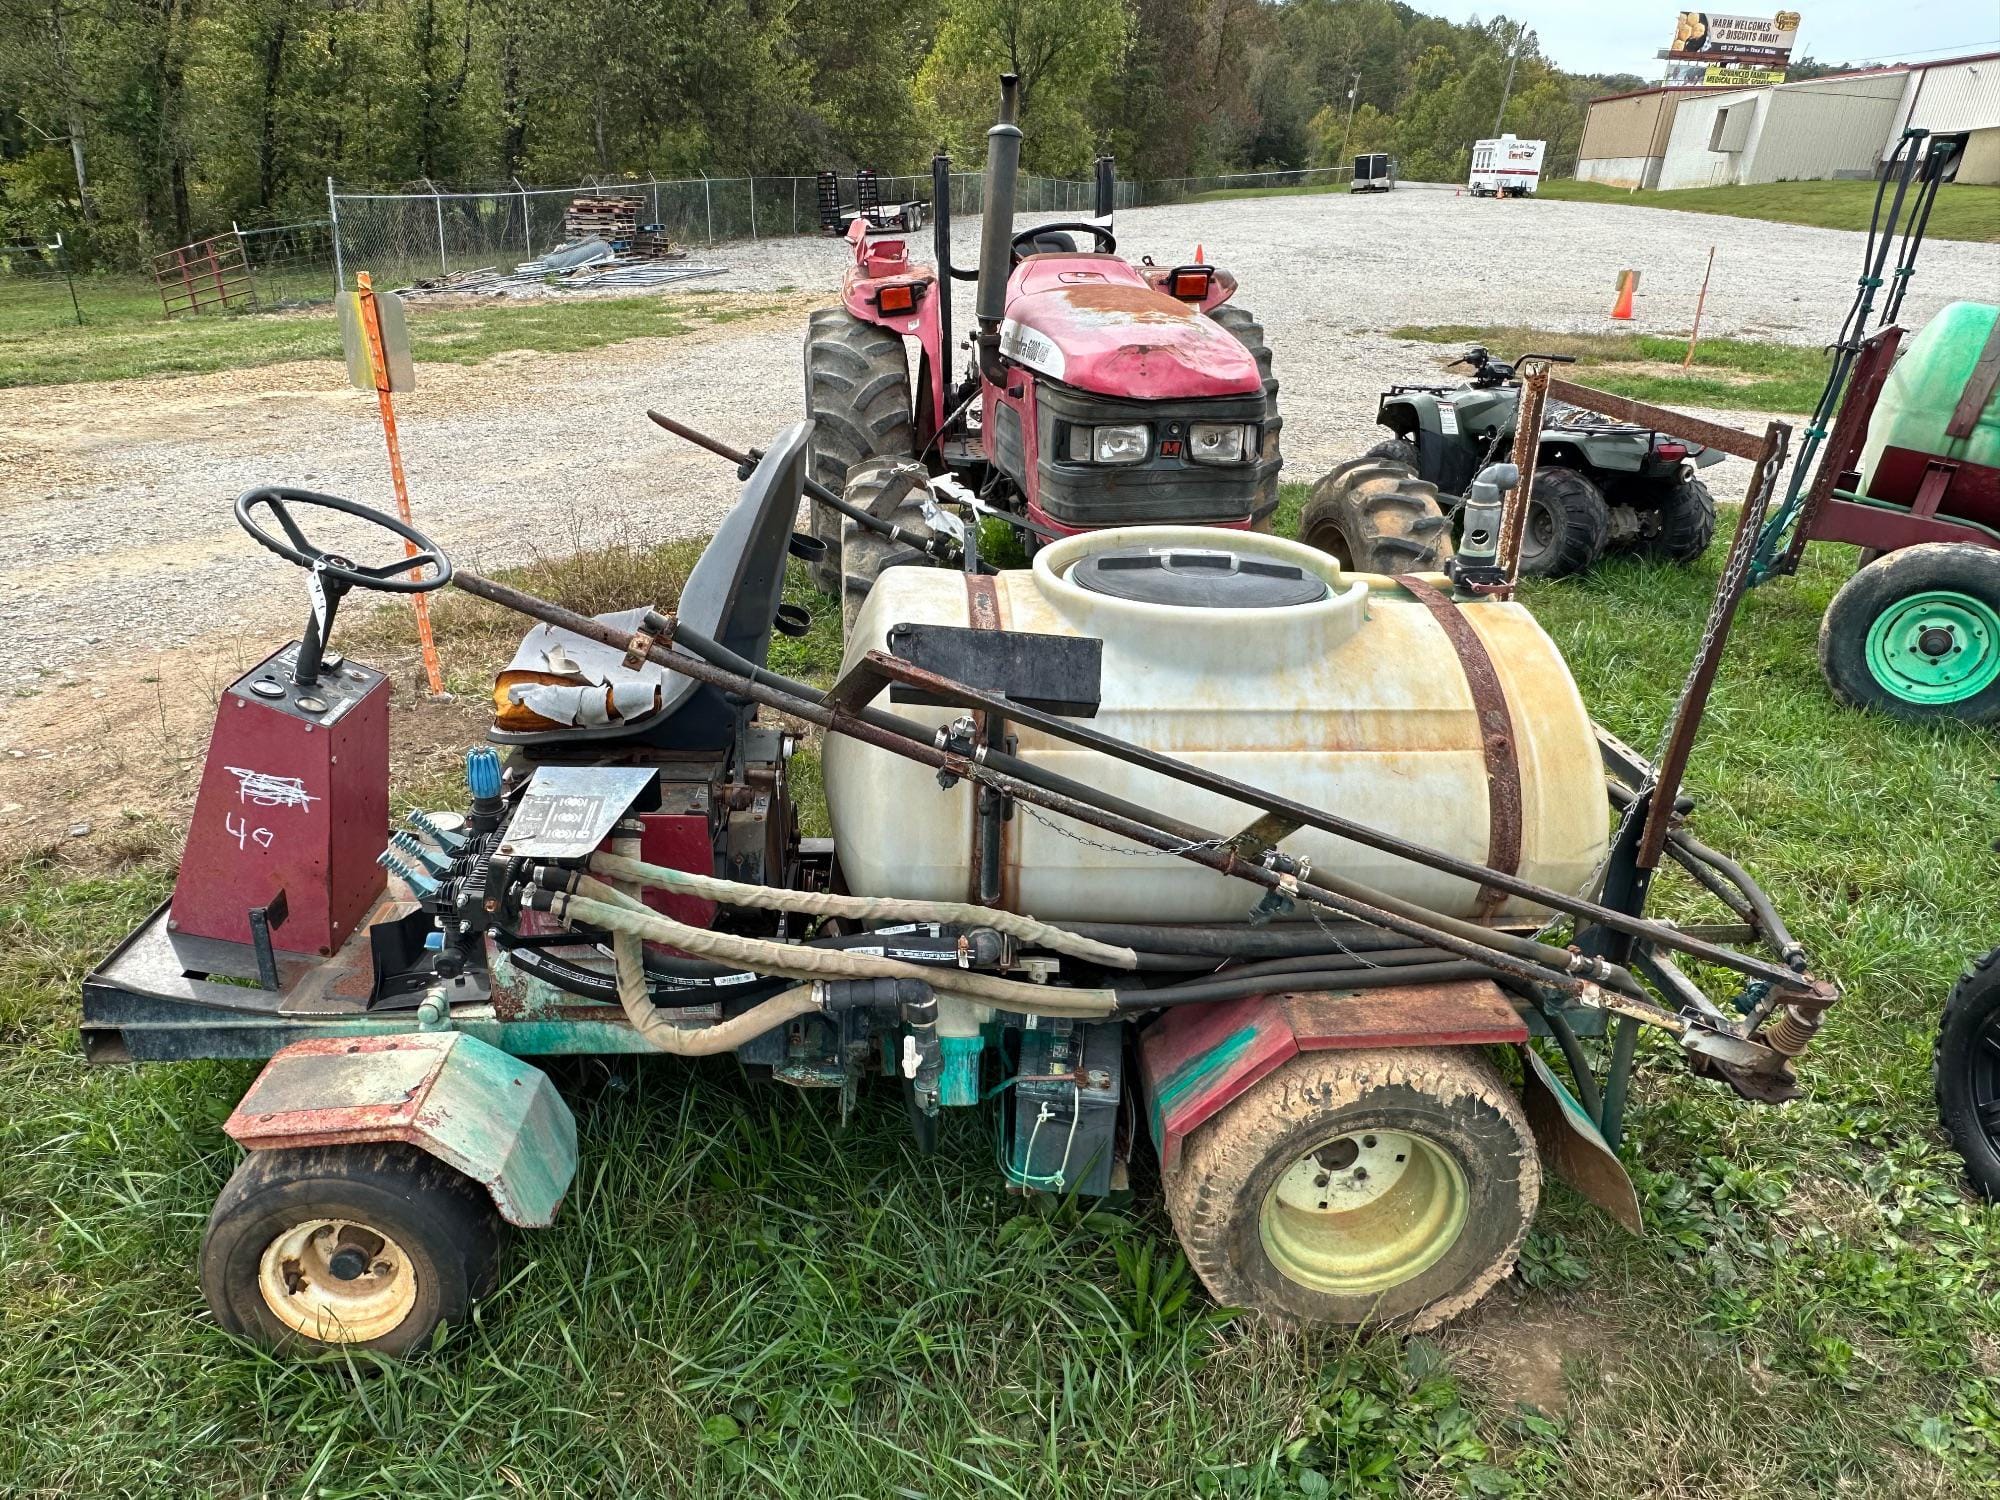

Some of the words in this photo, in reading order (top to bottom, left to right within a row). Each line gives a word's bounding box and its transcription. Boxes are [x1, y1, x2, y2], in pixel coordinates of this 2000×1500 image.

[1712, 18, 1732, 28] WARM
[1734, 20, 1771, 32] WELCOMES
[1717, 29, 1725, 39] &
[1726, 30, 1757, 41] BISCUITS
[1757, 33, 1779, 43] AWAIT
[1706, 75, 1731, 84] MEDICAL
[1719, 69, 1749, 78] ADVANCED
[1750, 71, 1770, 79] FAMILY
[225, 812, 273, 850] 40
